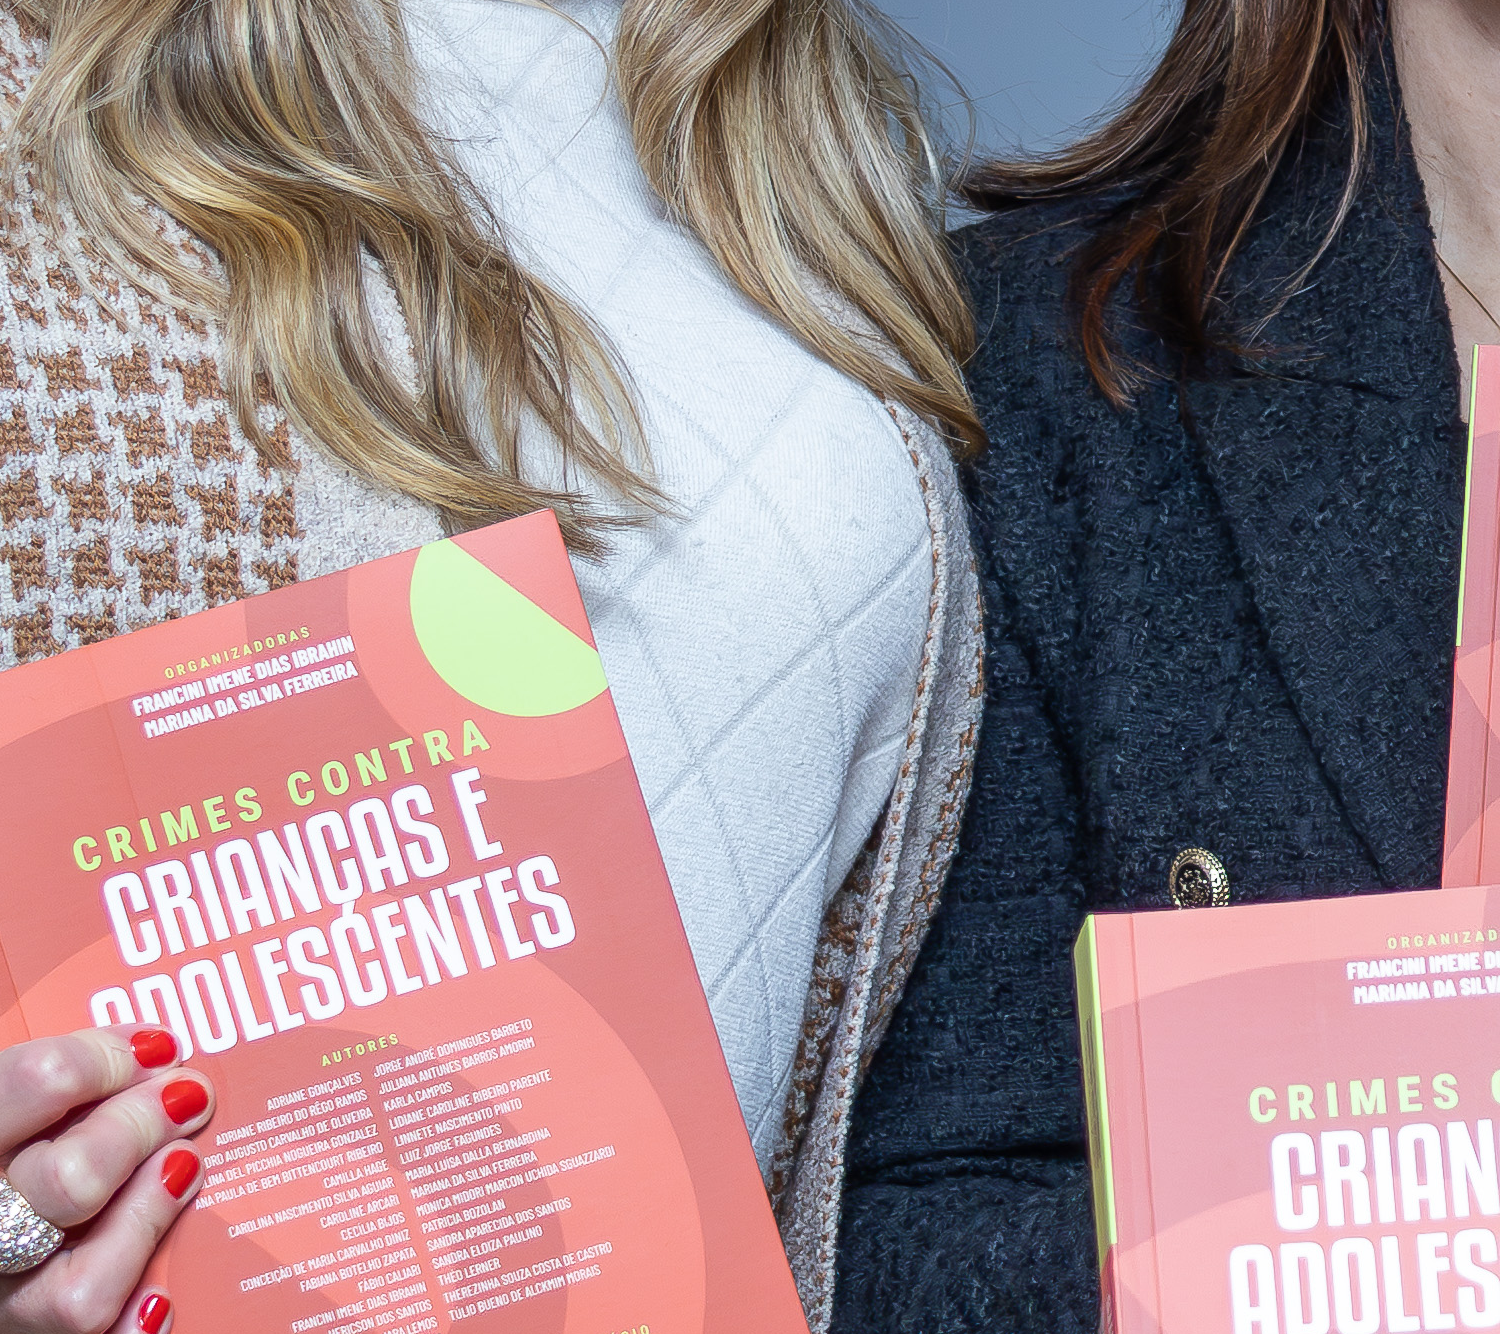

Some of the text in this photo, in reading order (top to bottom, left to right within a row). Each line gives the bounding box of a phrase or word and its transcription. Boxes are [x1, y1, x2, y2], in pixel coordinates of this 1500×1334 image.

[132, 635, 354, 716] FRANCINI IMENE DIAS IBRAHIN
[164, 626, 309, 678] ORGANIZADORAS
[143, 660, 358, 738] MARIANA DA SILVA FERREIRA
[72, 719, 490, 871] CRIMES CONTRA
[103, 767, 503, 967] CRIANÇAS E
[1346, 956, 1426, 980] FRANCINI
[1428, 951, 1481, 973] IMENE
[1353, 980, 1430, 1004] MARIANA
[1432, 978, 1457, 998] DA
[321, 1033, 398, 1066] AUTORES
[373, 1018, 532, 1077] JORGE ANDRÉ DOMINGUES BARRETO
[378, 1036, 535, 1094] JULIANA ANTUNES BARROS AMORIM
[383, 1081, 453, 1112] KARLA CAMPOS
[388, 1068, 552, 1129] LIDIANE CAROLINE RIBEIRO PARENTE
[393, 1097, 522, 1147] LINNETE NASCIMENTO PINTO
[1249, 1073, 1458, 1123] CRIMES
[399, 1123, 502, 1164] LUIZ JORGE FAGUNDES
[404, 1127, 551, 1181] MARIA LUÍSA DALLA BERNARDINA
